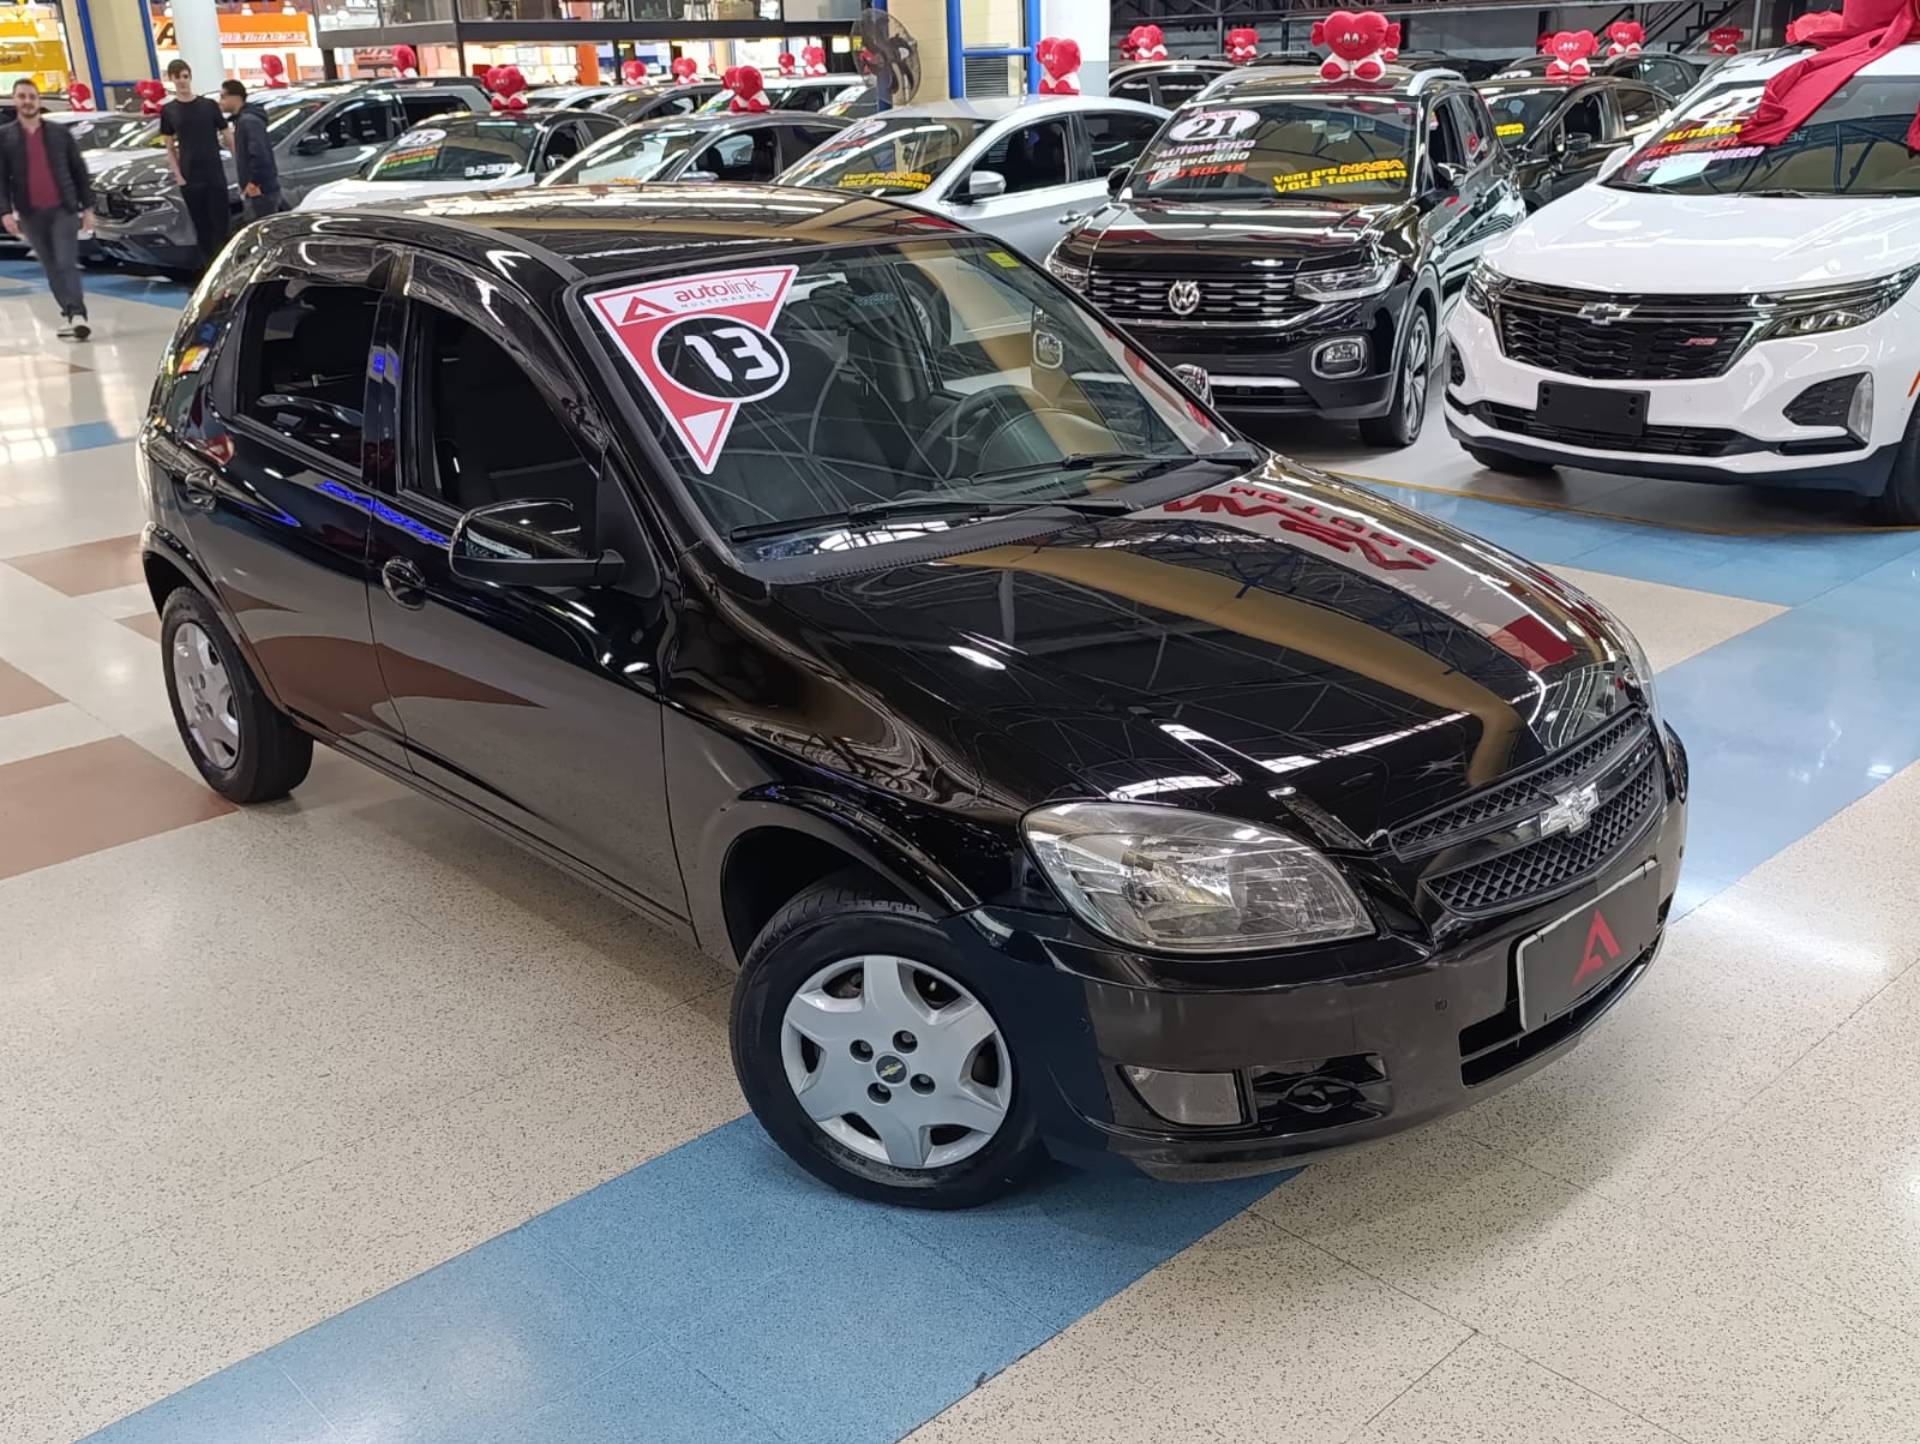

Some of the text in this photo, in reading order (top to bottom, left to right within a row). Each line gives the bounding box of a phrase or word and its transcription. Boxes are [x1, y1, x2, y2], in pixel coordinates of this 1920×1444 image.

[1185, 116, 1237, 139] 21
[1197, 151, 1251, 165] COURO
[1189, 163, 1247, 178] SOLAR
[1273, 171, 1308, 184] Vem
[1339, 159, 1405, 175] NASA
[674, 278, 764, 303] autolink
[684, 327, 780, 384] 13
